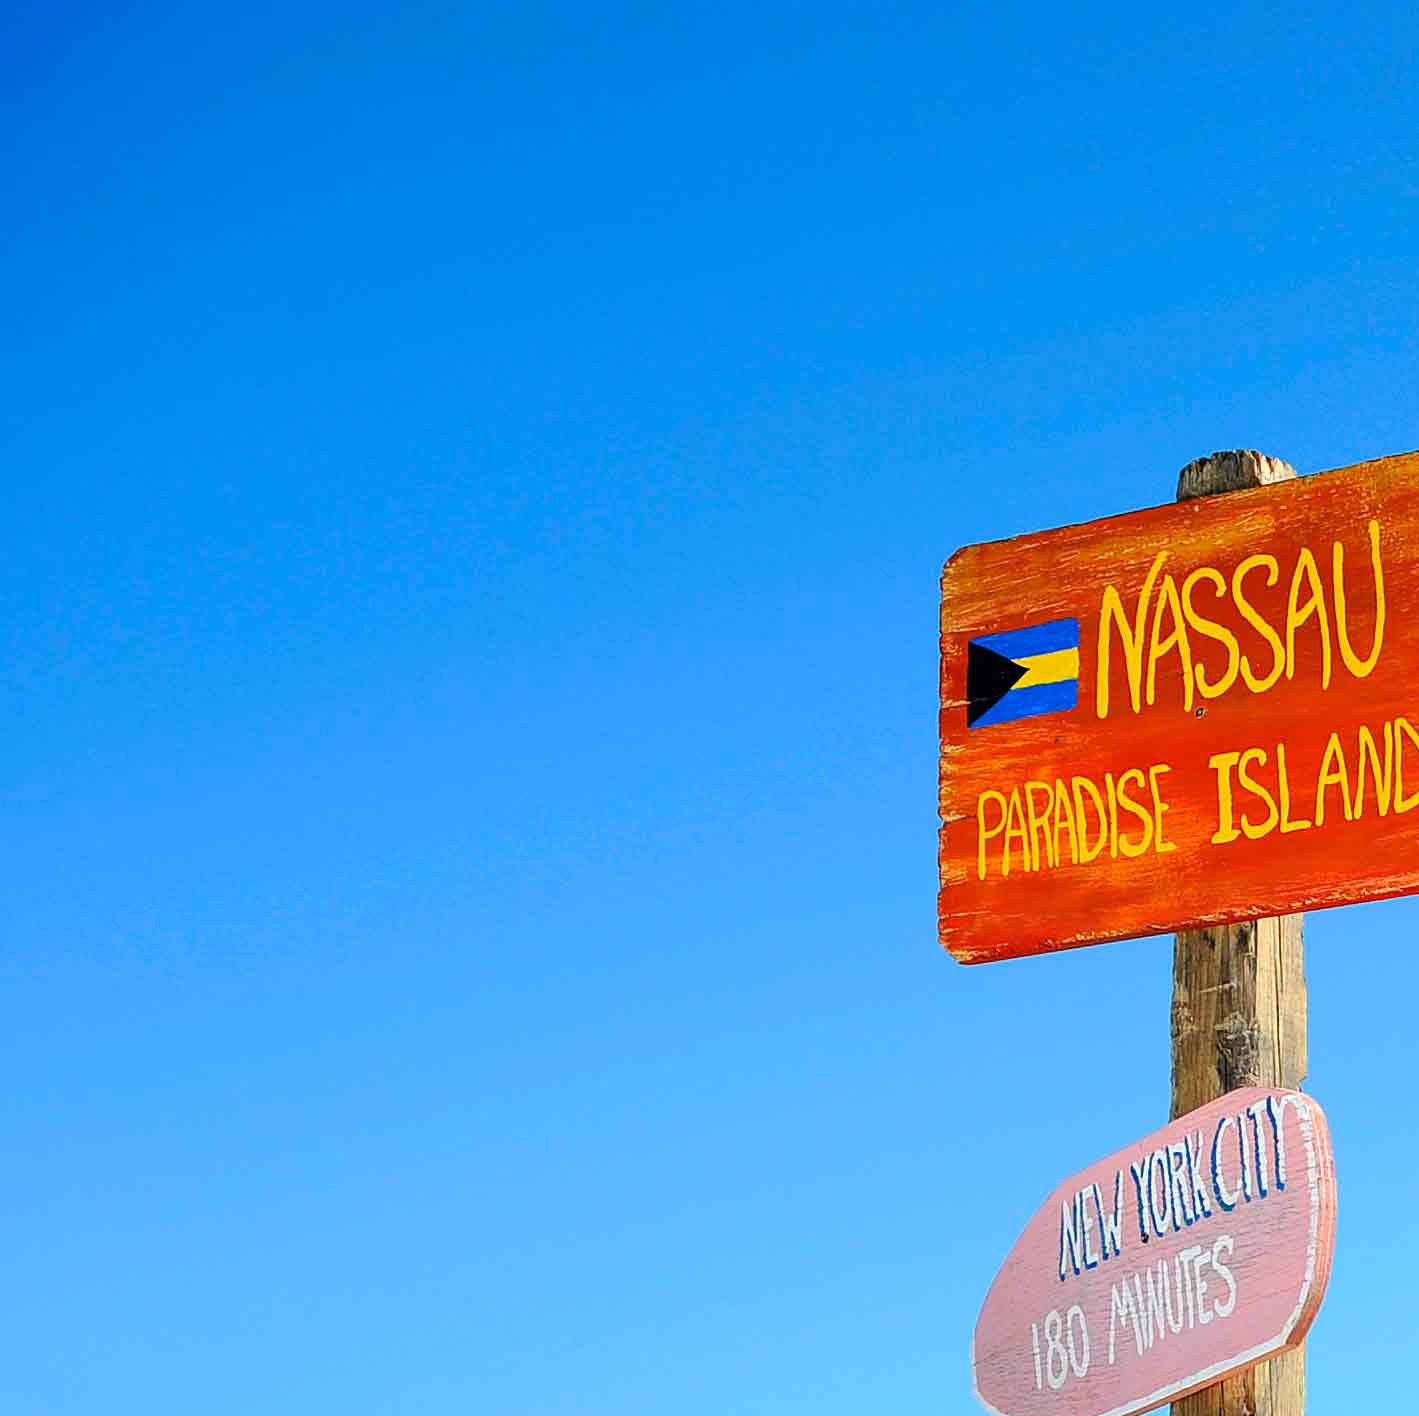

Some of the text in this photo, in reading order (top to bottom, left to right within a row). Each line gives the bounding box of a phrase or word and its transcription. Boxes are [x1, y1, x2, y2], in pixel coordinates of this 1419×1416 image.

[1097, 521, 1386, 718] NASSAU
[977, 764, 1177, 880] PARADISE
[1059, 1094, 1296, 1281] NEW YORK CITY
[1031, 1235, 1236, 1391] 180 MINUTES
